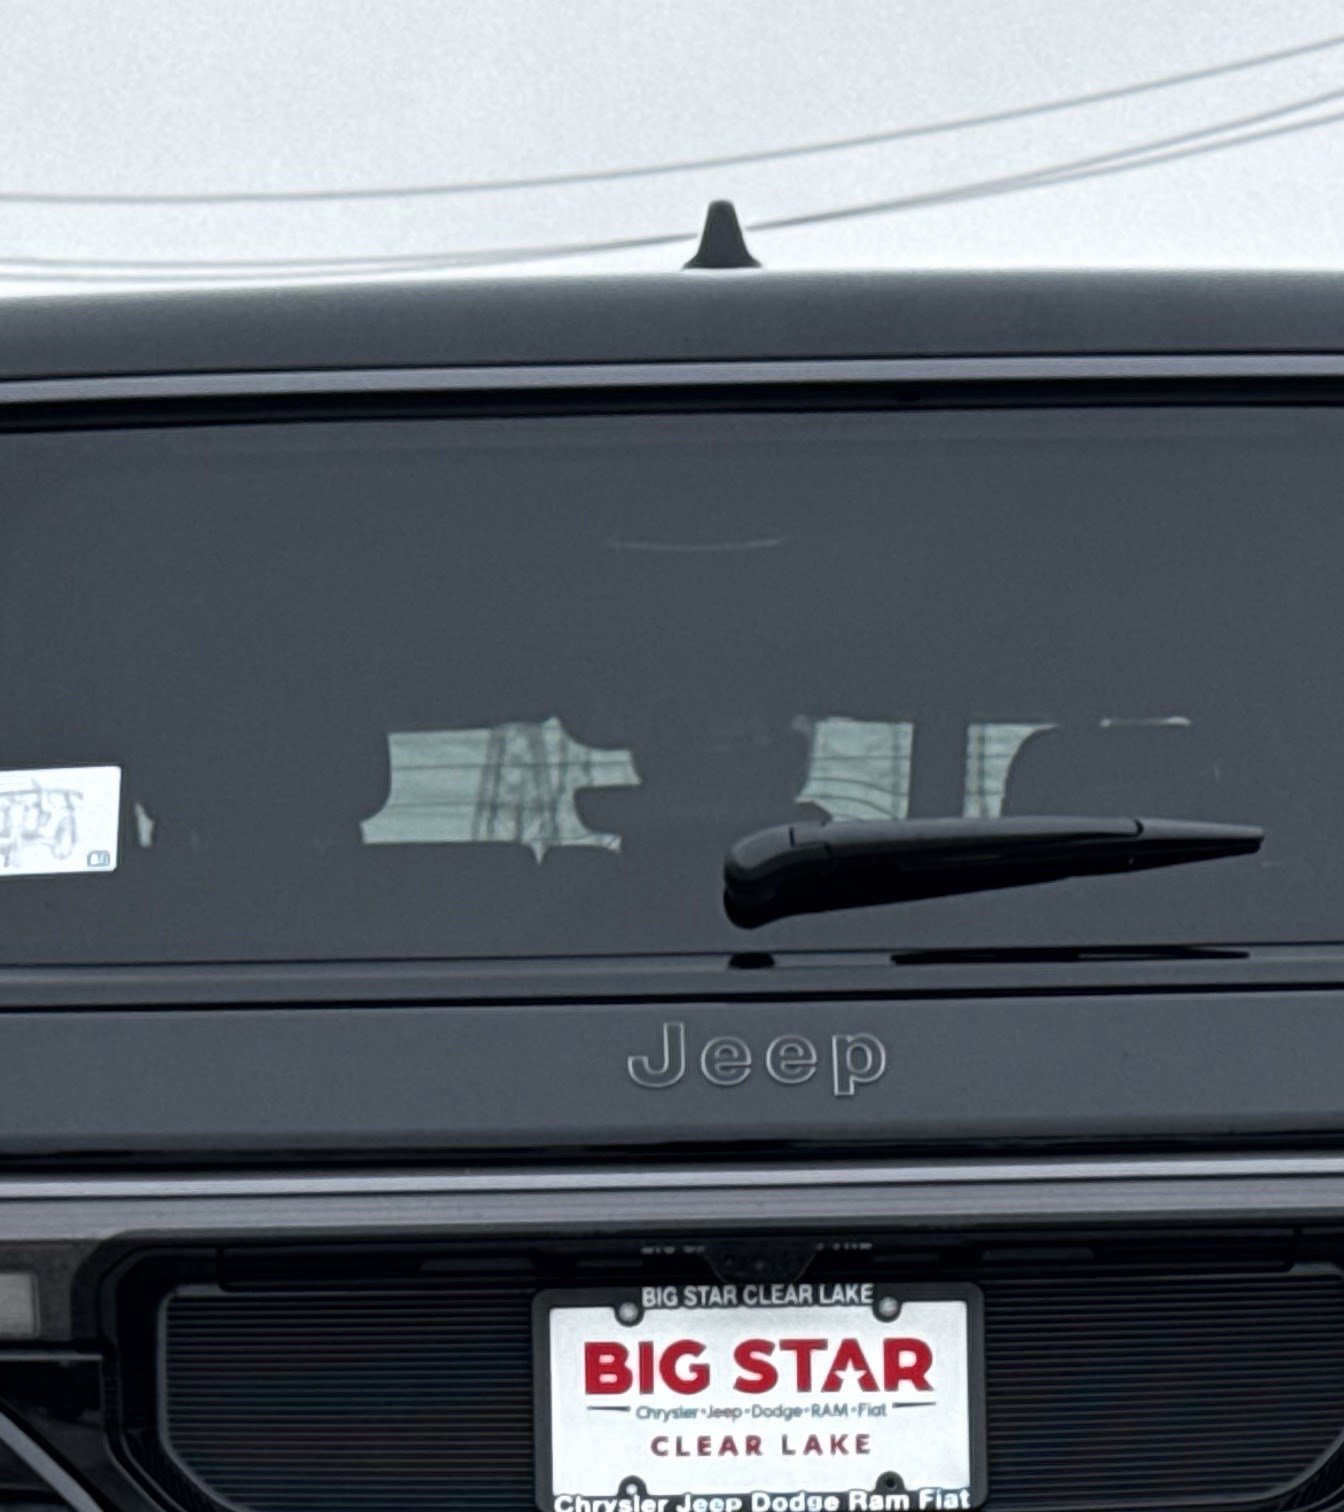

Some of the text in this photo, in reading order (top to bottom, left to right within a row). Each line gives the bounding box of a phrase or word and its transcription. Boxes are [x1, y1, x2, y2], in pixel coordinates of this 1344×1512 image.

[628, 1021, 886, 1096] Jeep
[641, 1283, 874, 1308] BIG STAR CLEAR LAKE
[584, 1337, 936, 1395] BIG STAR
[650, 1433, 872, 1457] CLEAR LAKE
[849, 1490, 911, 1512] Ram
[919, 1488, 971, 1510] Fiat
